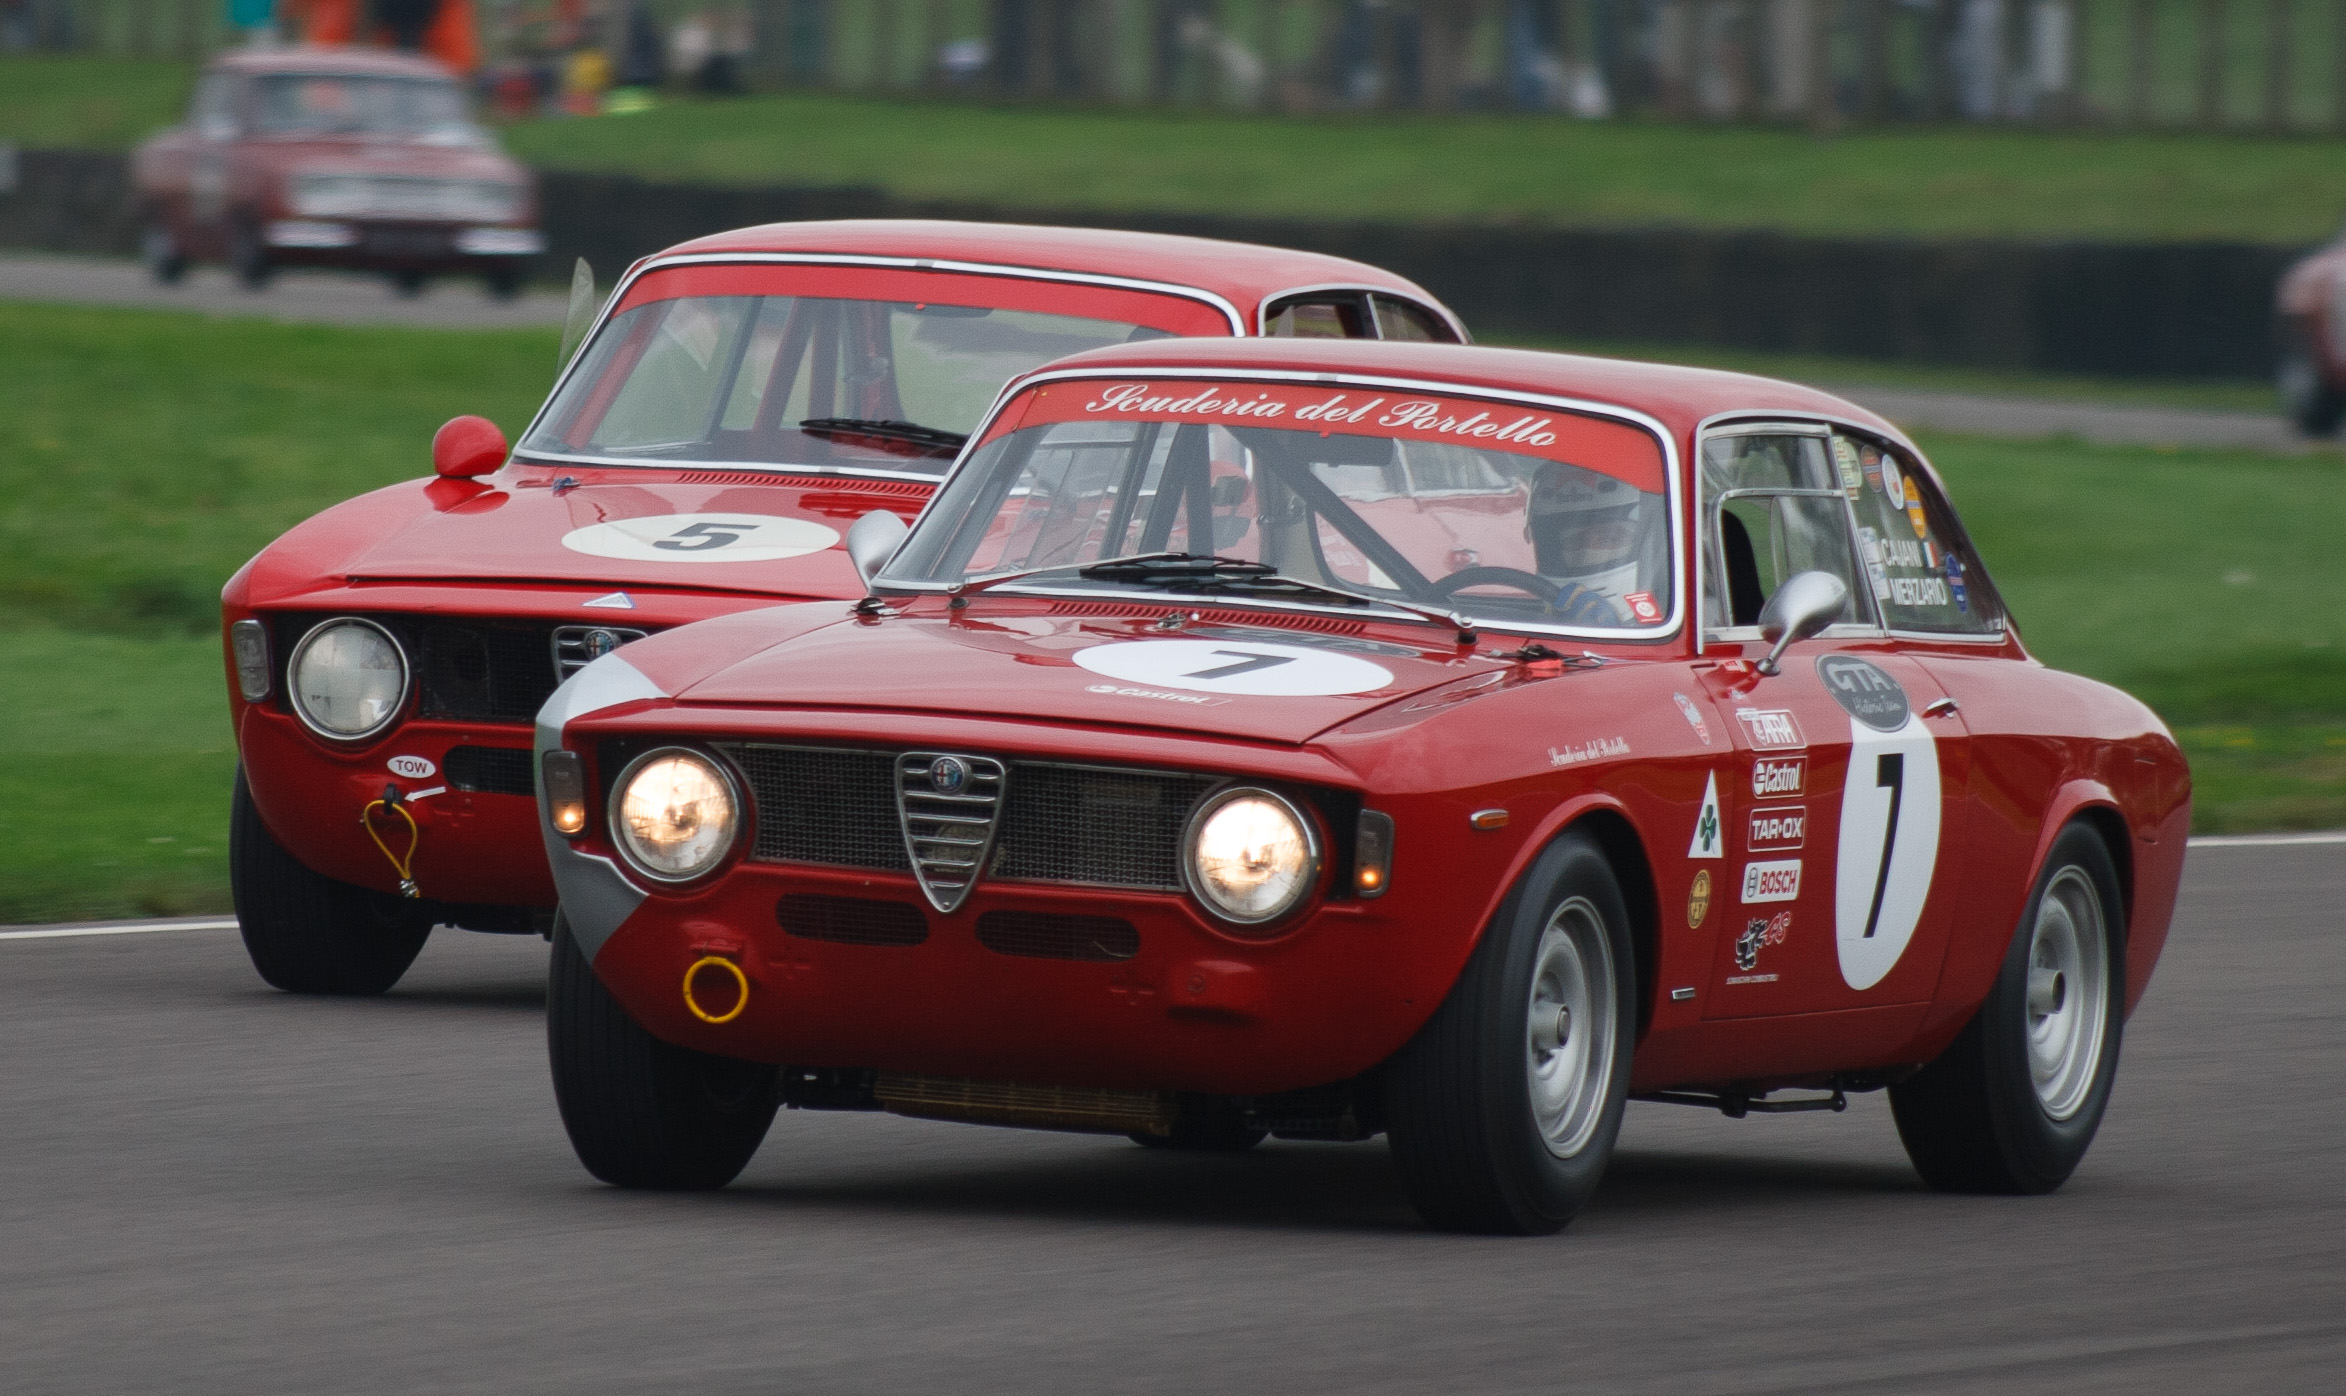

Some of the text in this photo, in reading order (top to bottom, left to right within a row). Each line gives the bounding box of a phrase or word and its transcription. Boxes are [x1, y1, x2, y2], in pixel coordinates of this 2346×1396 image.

[1085, 384, 1558, 448] Scuderia del Portello
[652, 522, 761, 551] 5
[1178, 650, 1299, 680] 7
[396, 760, 427, 774] TOW
[1765, 762, 1801, 793] Castrol
[1862, 752, 1905, 938] 7
[1759, 869, 1798, 895] BOSCH
